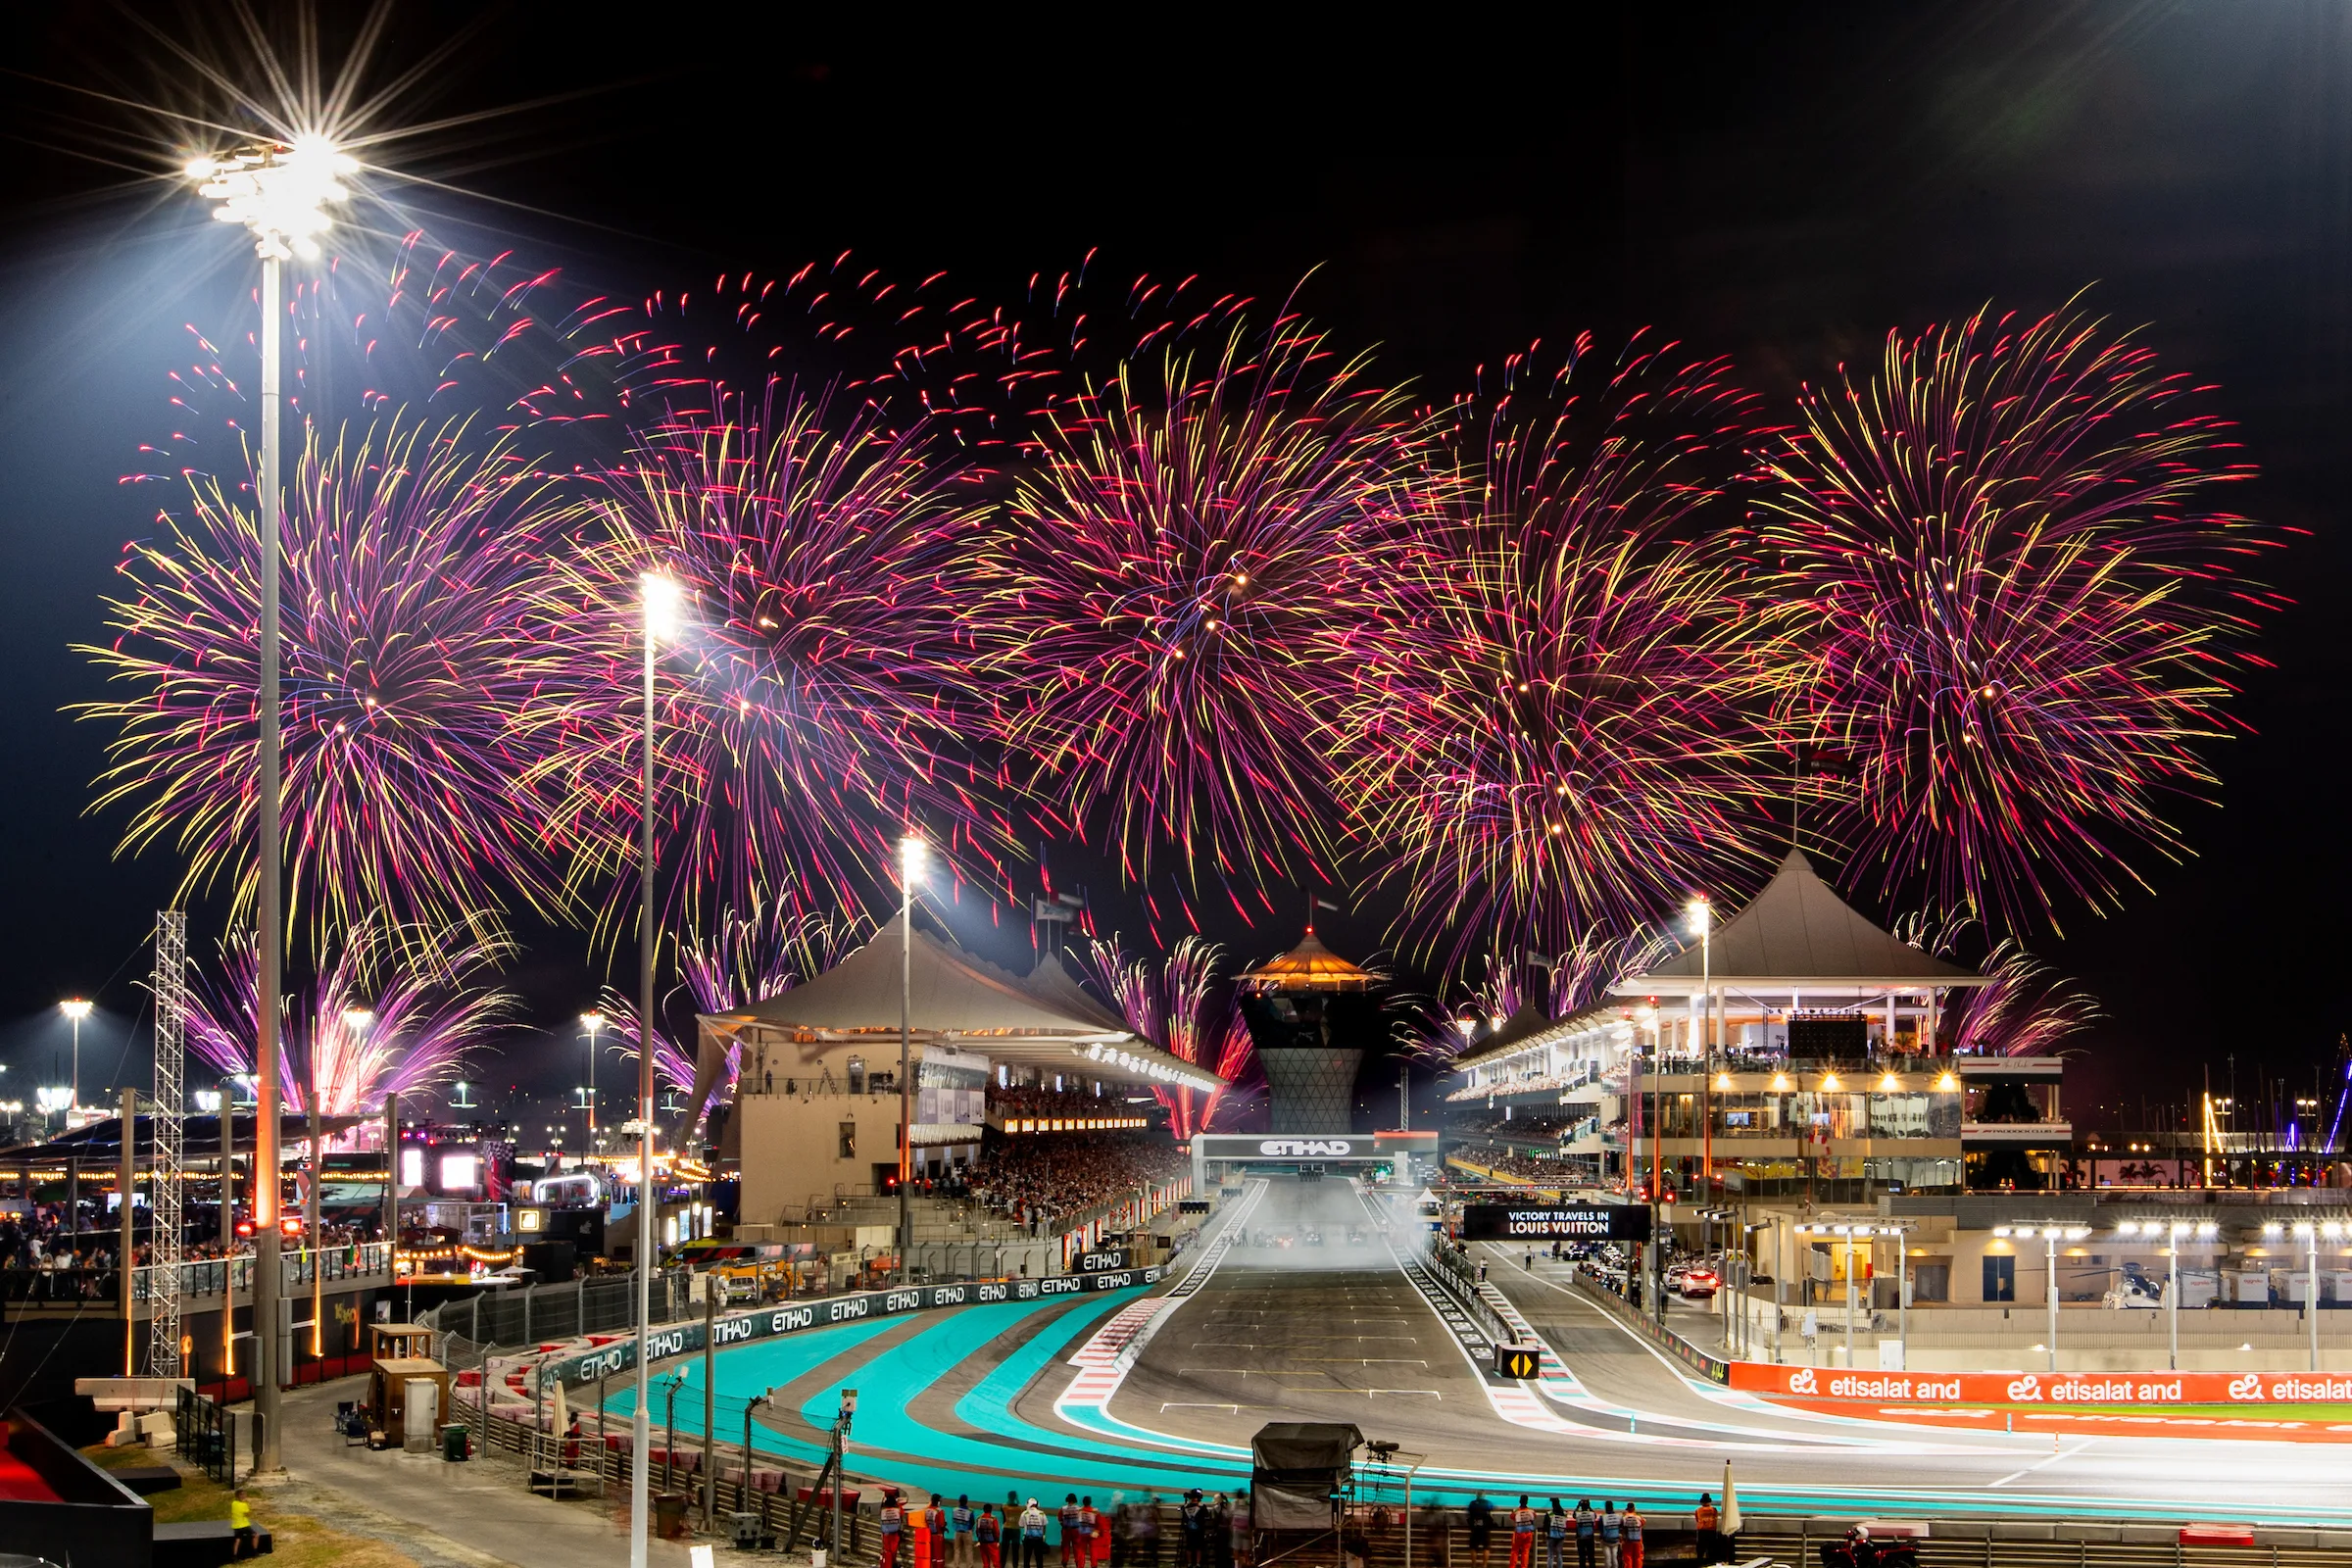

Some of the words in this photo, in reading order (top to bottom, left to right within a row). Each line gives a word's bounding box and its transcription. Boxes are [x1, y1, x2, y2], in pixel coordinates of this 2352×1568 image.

[1260, 1141, 1350, 1155] ETIHAD
[2146, 1193, 2195, 1201] PADDOCK
[1508, 1211, 1550, 1221] VICTORY
[1553, 1211, 1594, 1221] TRAVELS
[1597, 1211, 1609, 1221] IN
[1509, 1222, 1548, 1234] LOUIS
[1552, 1222, 1609, 1234] VUITTON
[1083, 1251, 1121, 1271] ETIHAD
[1018, 1282, 1038, 1298] ETIHAD
[1041, 1277, 1081, 1294] ETIHAD
[1098, 1273, 1131, 1290] ETIHAD
[887, 1291, 920, 1312] ETIHAD
[935, 1286, 965, 1305] ETIHAD
[980, 1284, 1006, 1301] ETIHAD
[830, 1298, 868, 1321] ETIHAD
[771, 1307, 812, 1333] ETIHAD
[713, 1318, 753, 1344] TIHAD
[580, 1349, 622, 1382] ETIHD
[1789, 1368, 1819, 1395] e&
[1830, 1376, 1911, 1398] etisalat
[1916, 1378, 1960, 1400] and
[2007, 1375, 2043, 1400] e&
[2051, 1379, 2132, 1400] etisalat
[2138, 1379, 2181, 1400] and
[2229, 1374, 2265, 1400] e&
[2272, 1379, 2352, 1400] etisalat
